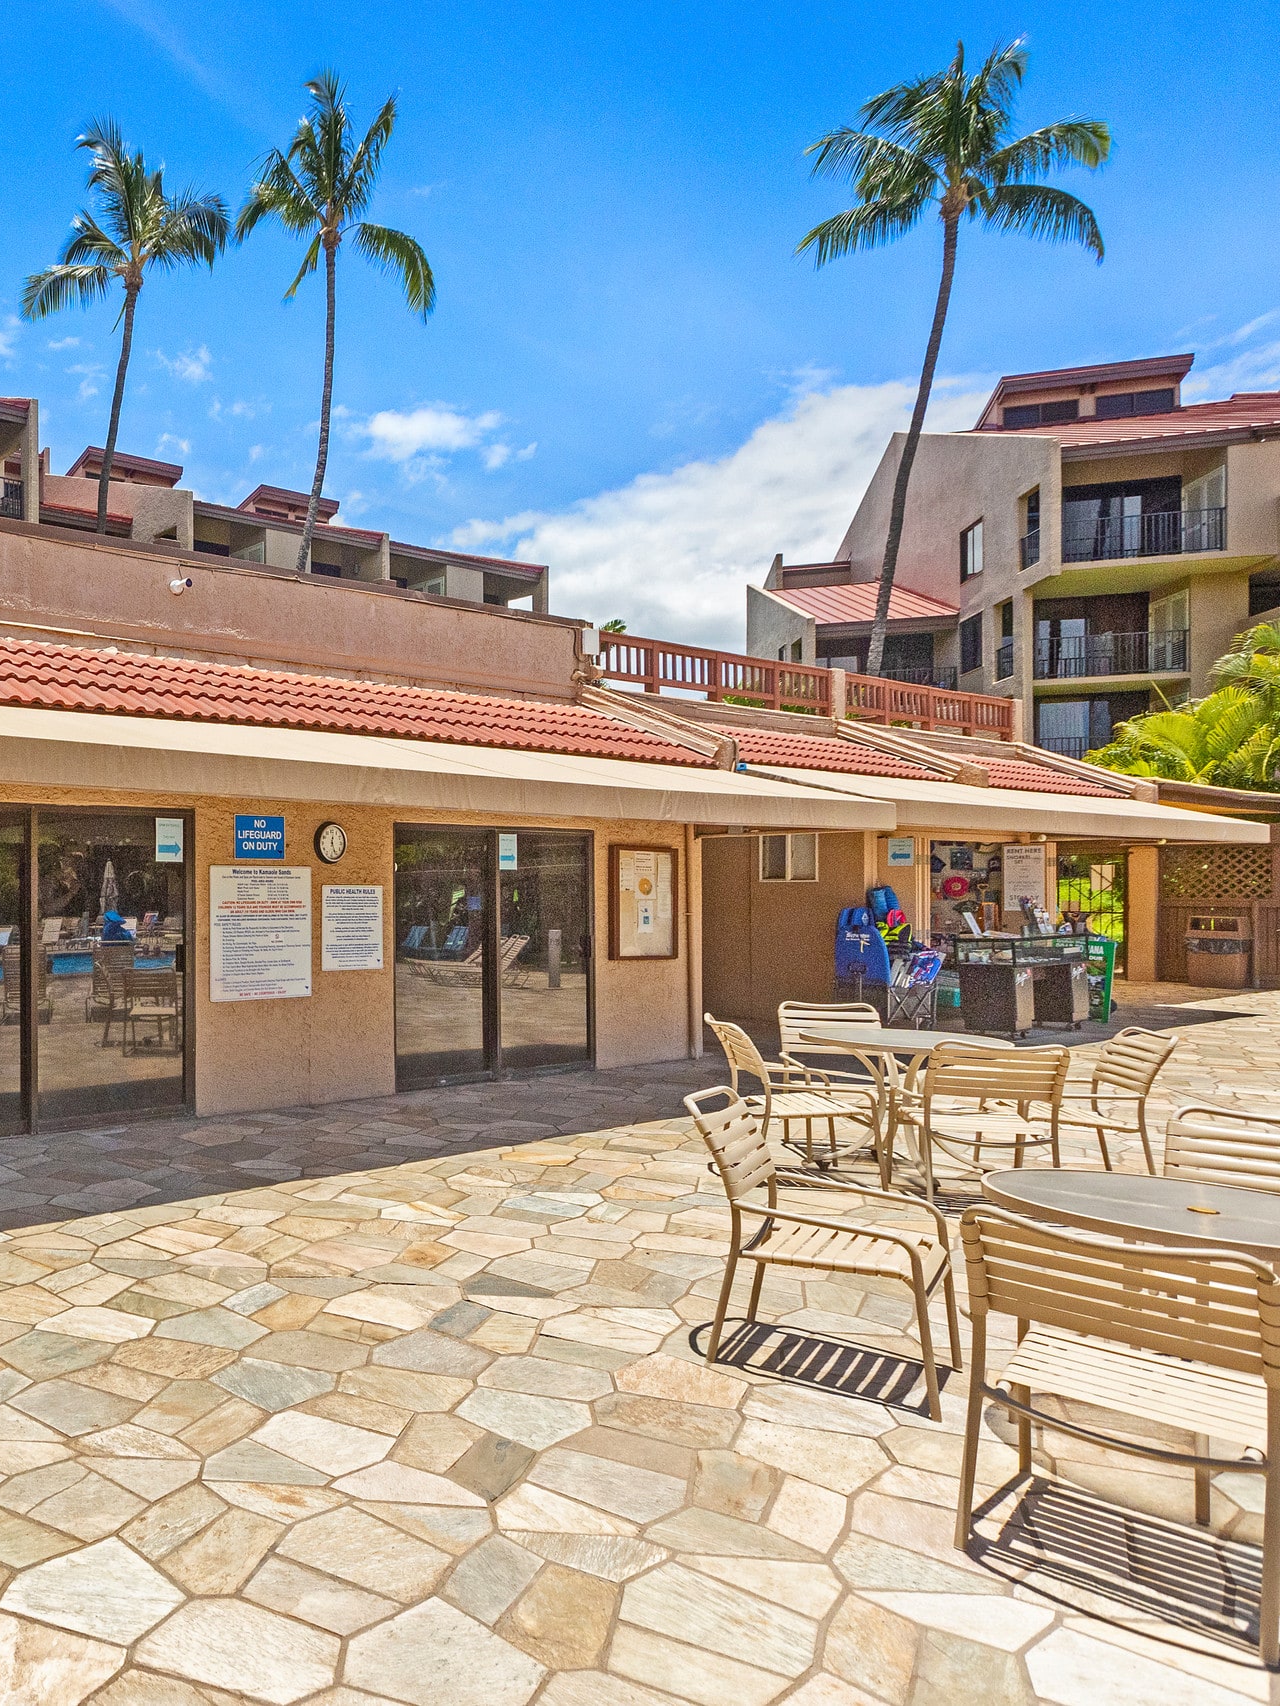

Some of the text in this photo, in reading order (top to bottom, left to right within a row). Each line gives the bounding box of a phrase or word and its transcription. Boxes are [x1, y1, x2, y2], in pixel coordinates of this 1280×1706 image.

[253, 819, 266, 828] NO
[237, 830, 282, 840] LIFEGUARD
[242, 841, 278, 851] ON DUTY
